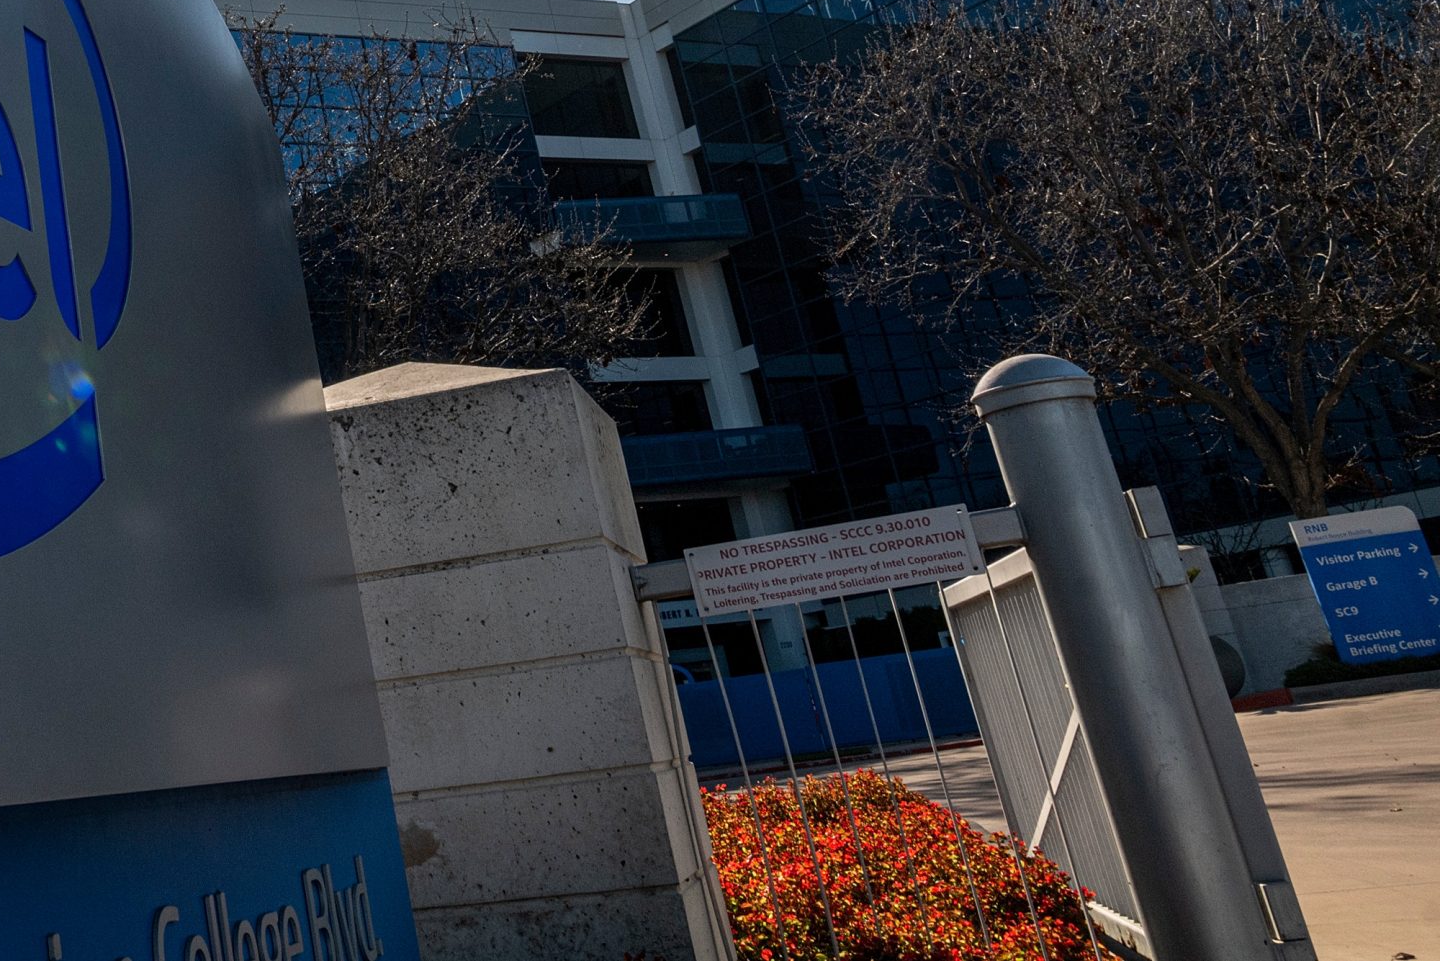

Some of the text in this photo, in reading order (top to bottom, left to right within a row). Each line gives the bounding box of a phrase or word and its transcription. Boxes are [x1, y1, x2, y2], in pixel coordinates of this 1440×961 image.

[720, 547, 738, 559] NO
[742, 532, 829, 556] TRESPASSING
[840, 525, 873, 540] SCCC
[875, 516, 931, 535] 9.30.010
[1304, 523, 1328, 534] RNB
[698, 564, 748, 580] PRIVATE
[750, 553, 816, 573] PROPERTY
[828, 545, 867, 560] INTEL
[870, 529, 966, 553] CORPORATION
[1316, 546, 1401, 566] Visitor Parking
[705, 550, 967, 596] This facility is the private property of Intel Coporation.
[713, 562, 965, 609] Loitering, Trespassing and Soliciation are Prohibited
[1326, 576, 1378, 592] Garage B
[1335, 606, 1359, 618] SC9
[1344, 628, 1402, 643] Executive
[1349, 638, 1438, 657] Briefing Center
[302, 854, 384, 961] Blvd.
